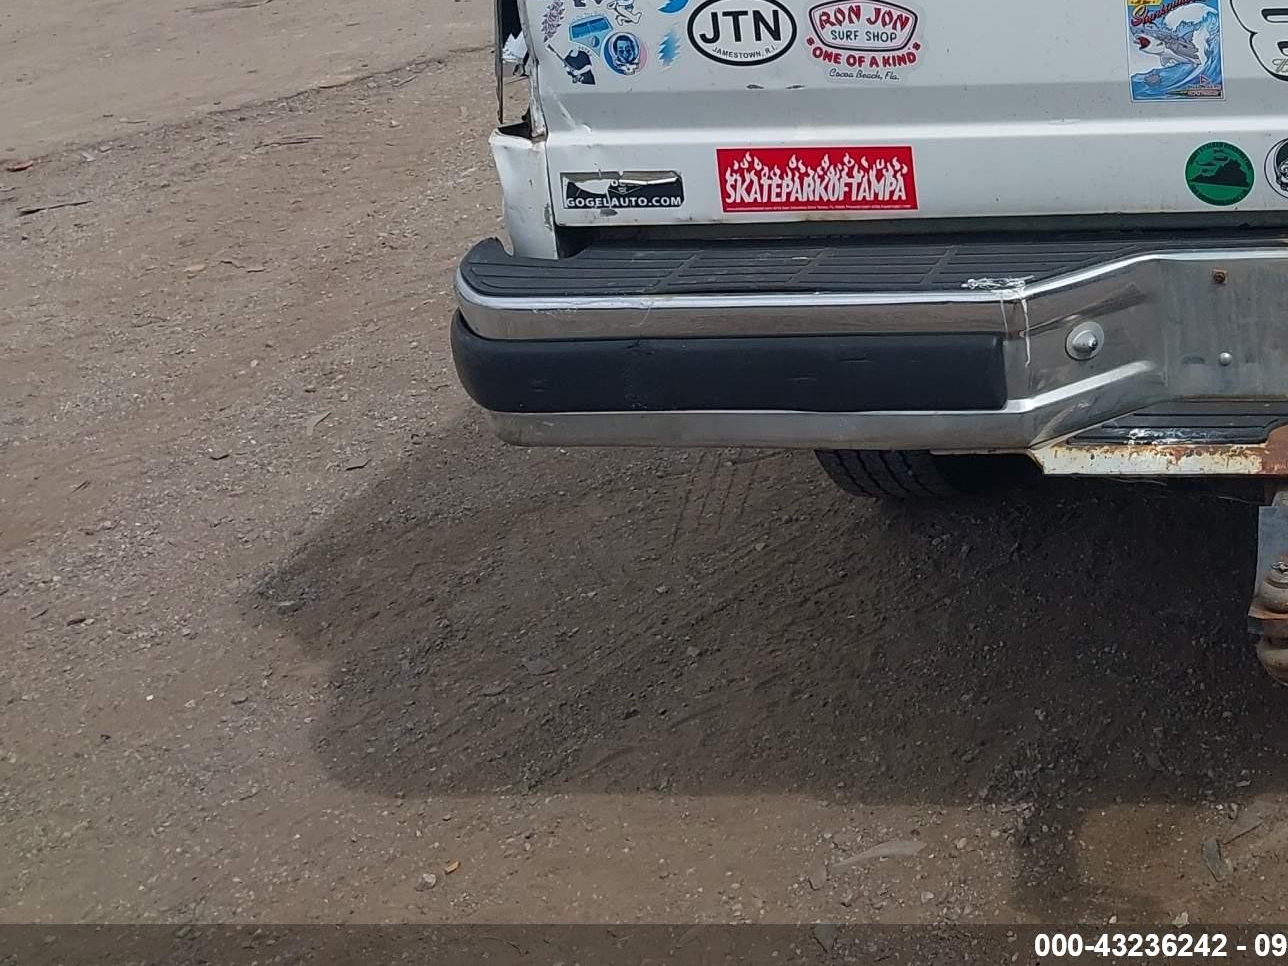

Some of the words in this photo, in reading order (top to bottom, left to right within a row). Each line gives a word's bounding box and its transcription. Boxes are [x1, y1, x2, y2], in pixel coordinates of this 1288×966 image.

[819, 4, 861, 31] RON
[866, 7, 910, 32] JON
[699, 9, 781, 44] JTN
[831, 30, 859, 41] SURF
[866, 31, 897, 42] SHOP
[812, 47, 842, 65] ONE
[846, 52, 866, 67] OF
[869, 53, 880, 68] A
[882, 51, 918, 67] KIND
[829, 68, 854, 78] Cocoa
[566, 196, 681, 207] GOGELAUTO.COM
